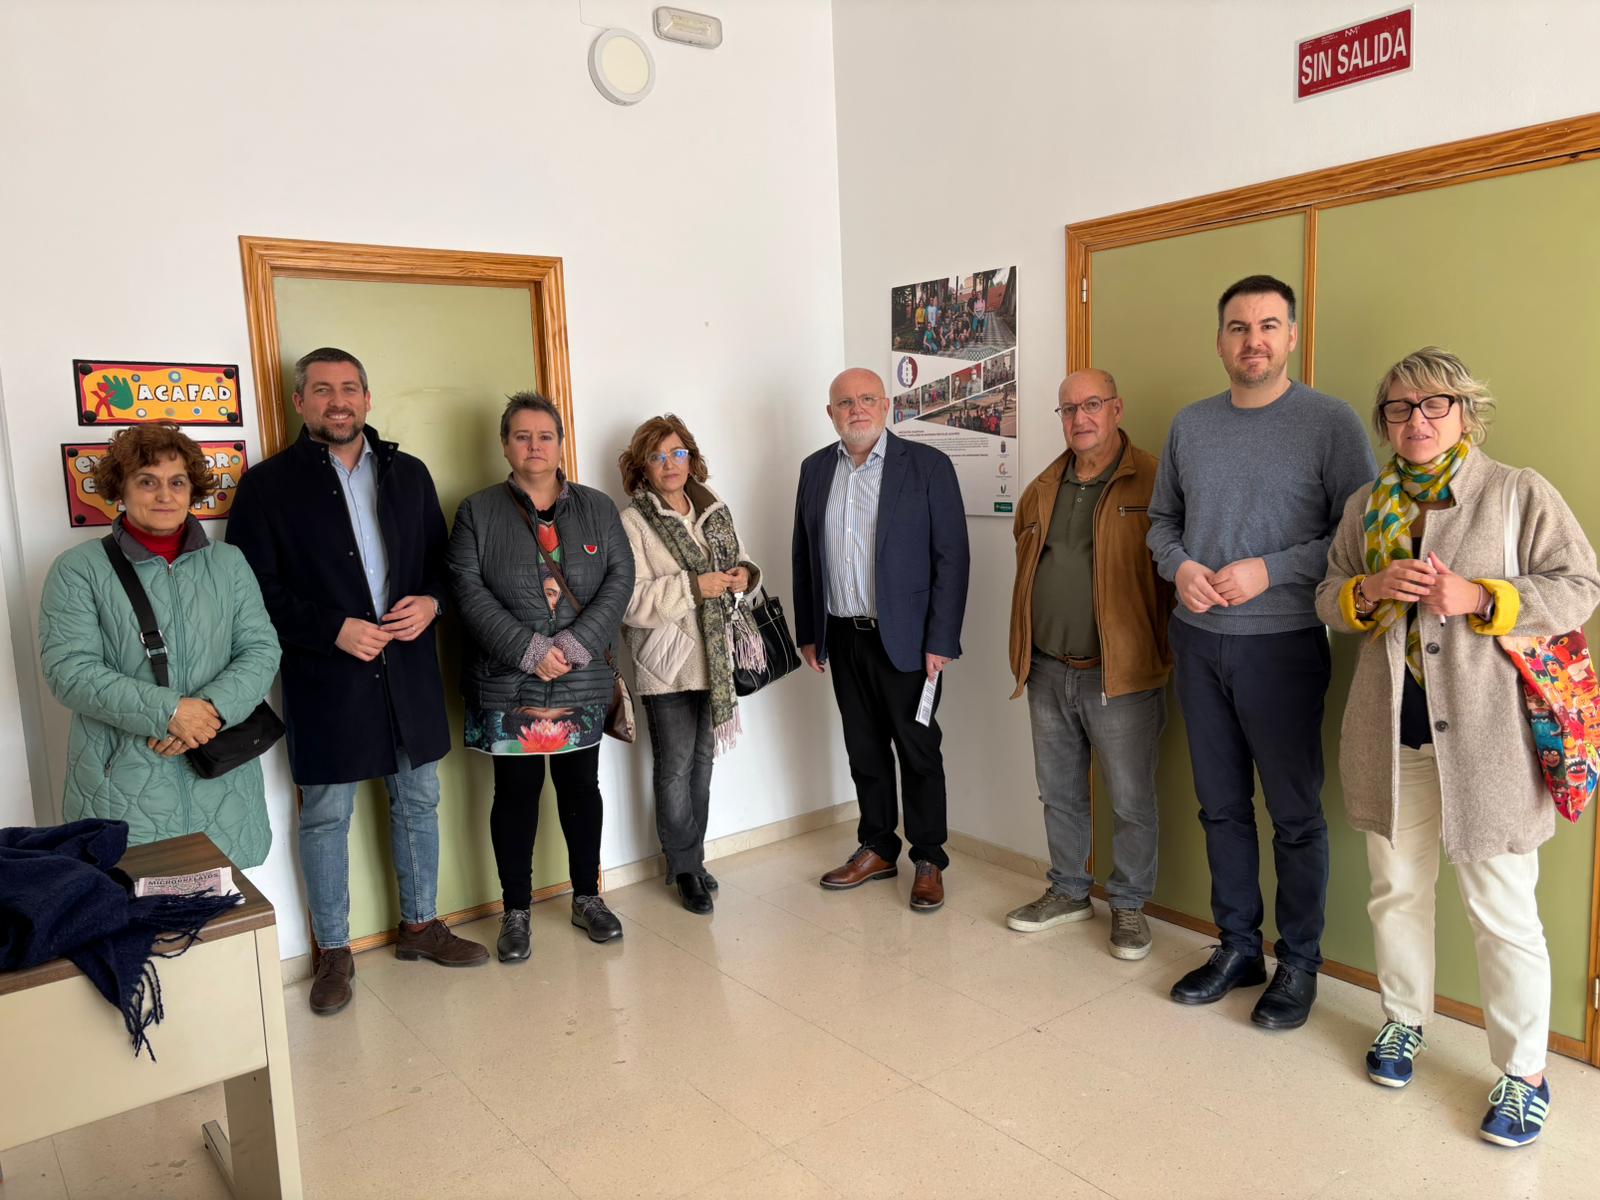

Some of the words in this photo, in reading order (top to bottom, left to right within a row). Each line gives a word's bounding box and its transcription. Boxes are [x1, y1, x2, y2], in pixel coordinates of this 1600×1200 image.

[1301, 48, 1332, 86] SIN
[1337, 27, 1408, 75] SALIDA
[137, 383, 232, 402] ACAFAD
